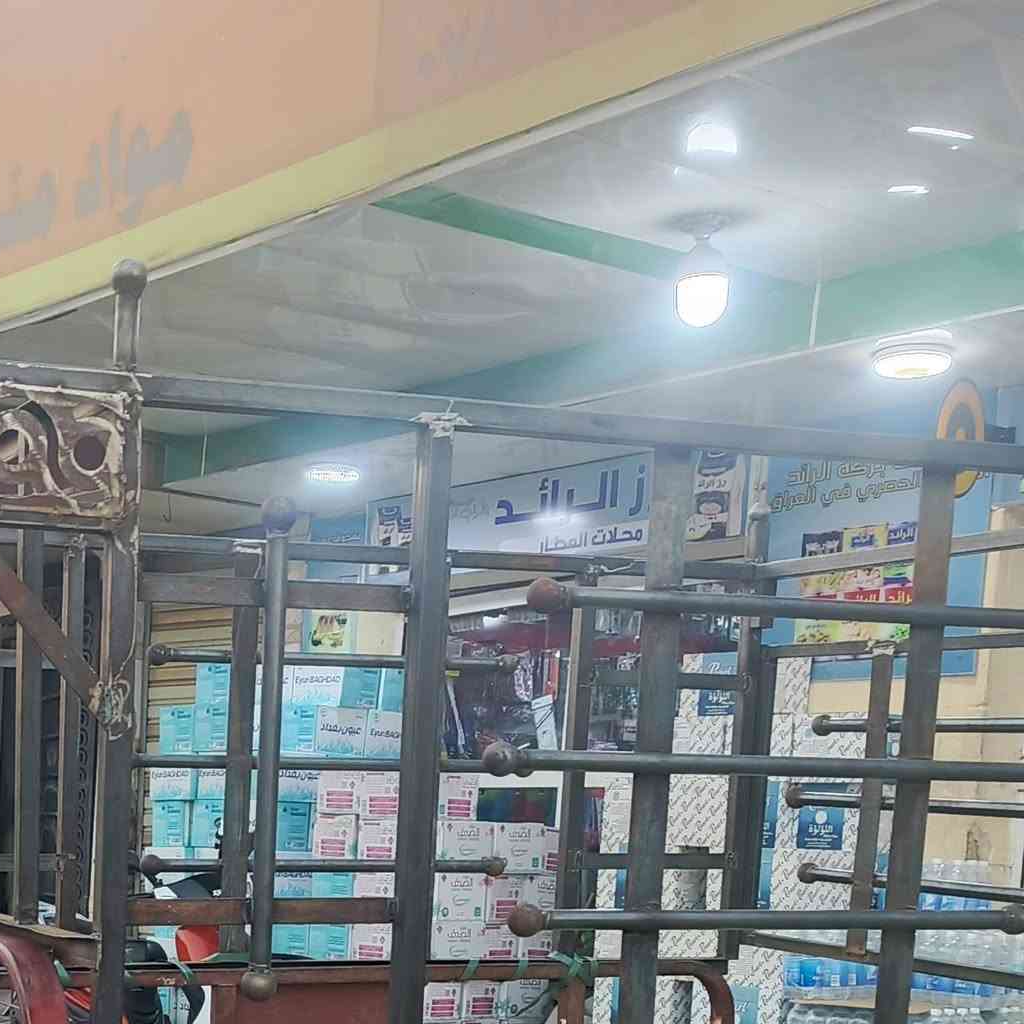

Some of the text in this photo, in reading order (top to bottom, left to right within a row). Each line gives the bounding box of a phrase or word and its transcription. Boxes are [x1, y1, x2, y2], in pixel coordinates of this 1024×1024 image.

[822, 482, 853, 507] في
[856, 469, 921, 503] الحصري
[592, 526, 644, 547] محلات
